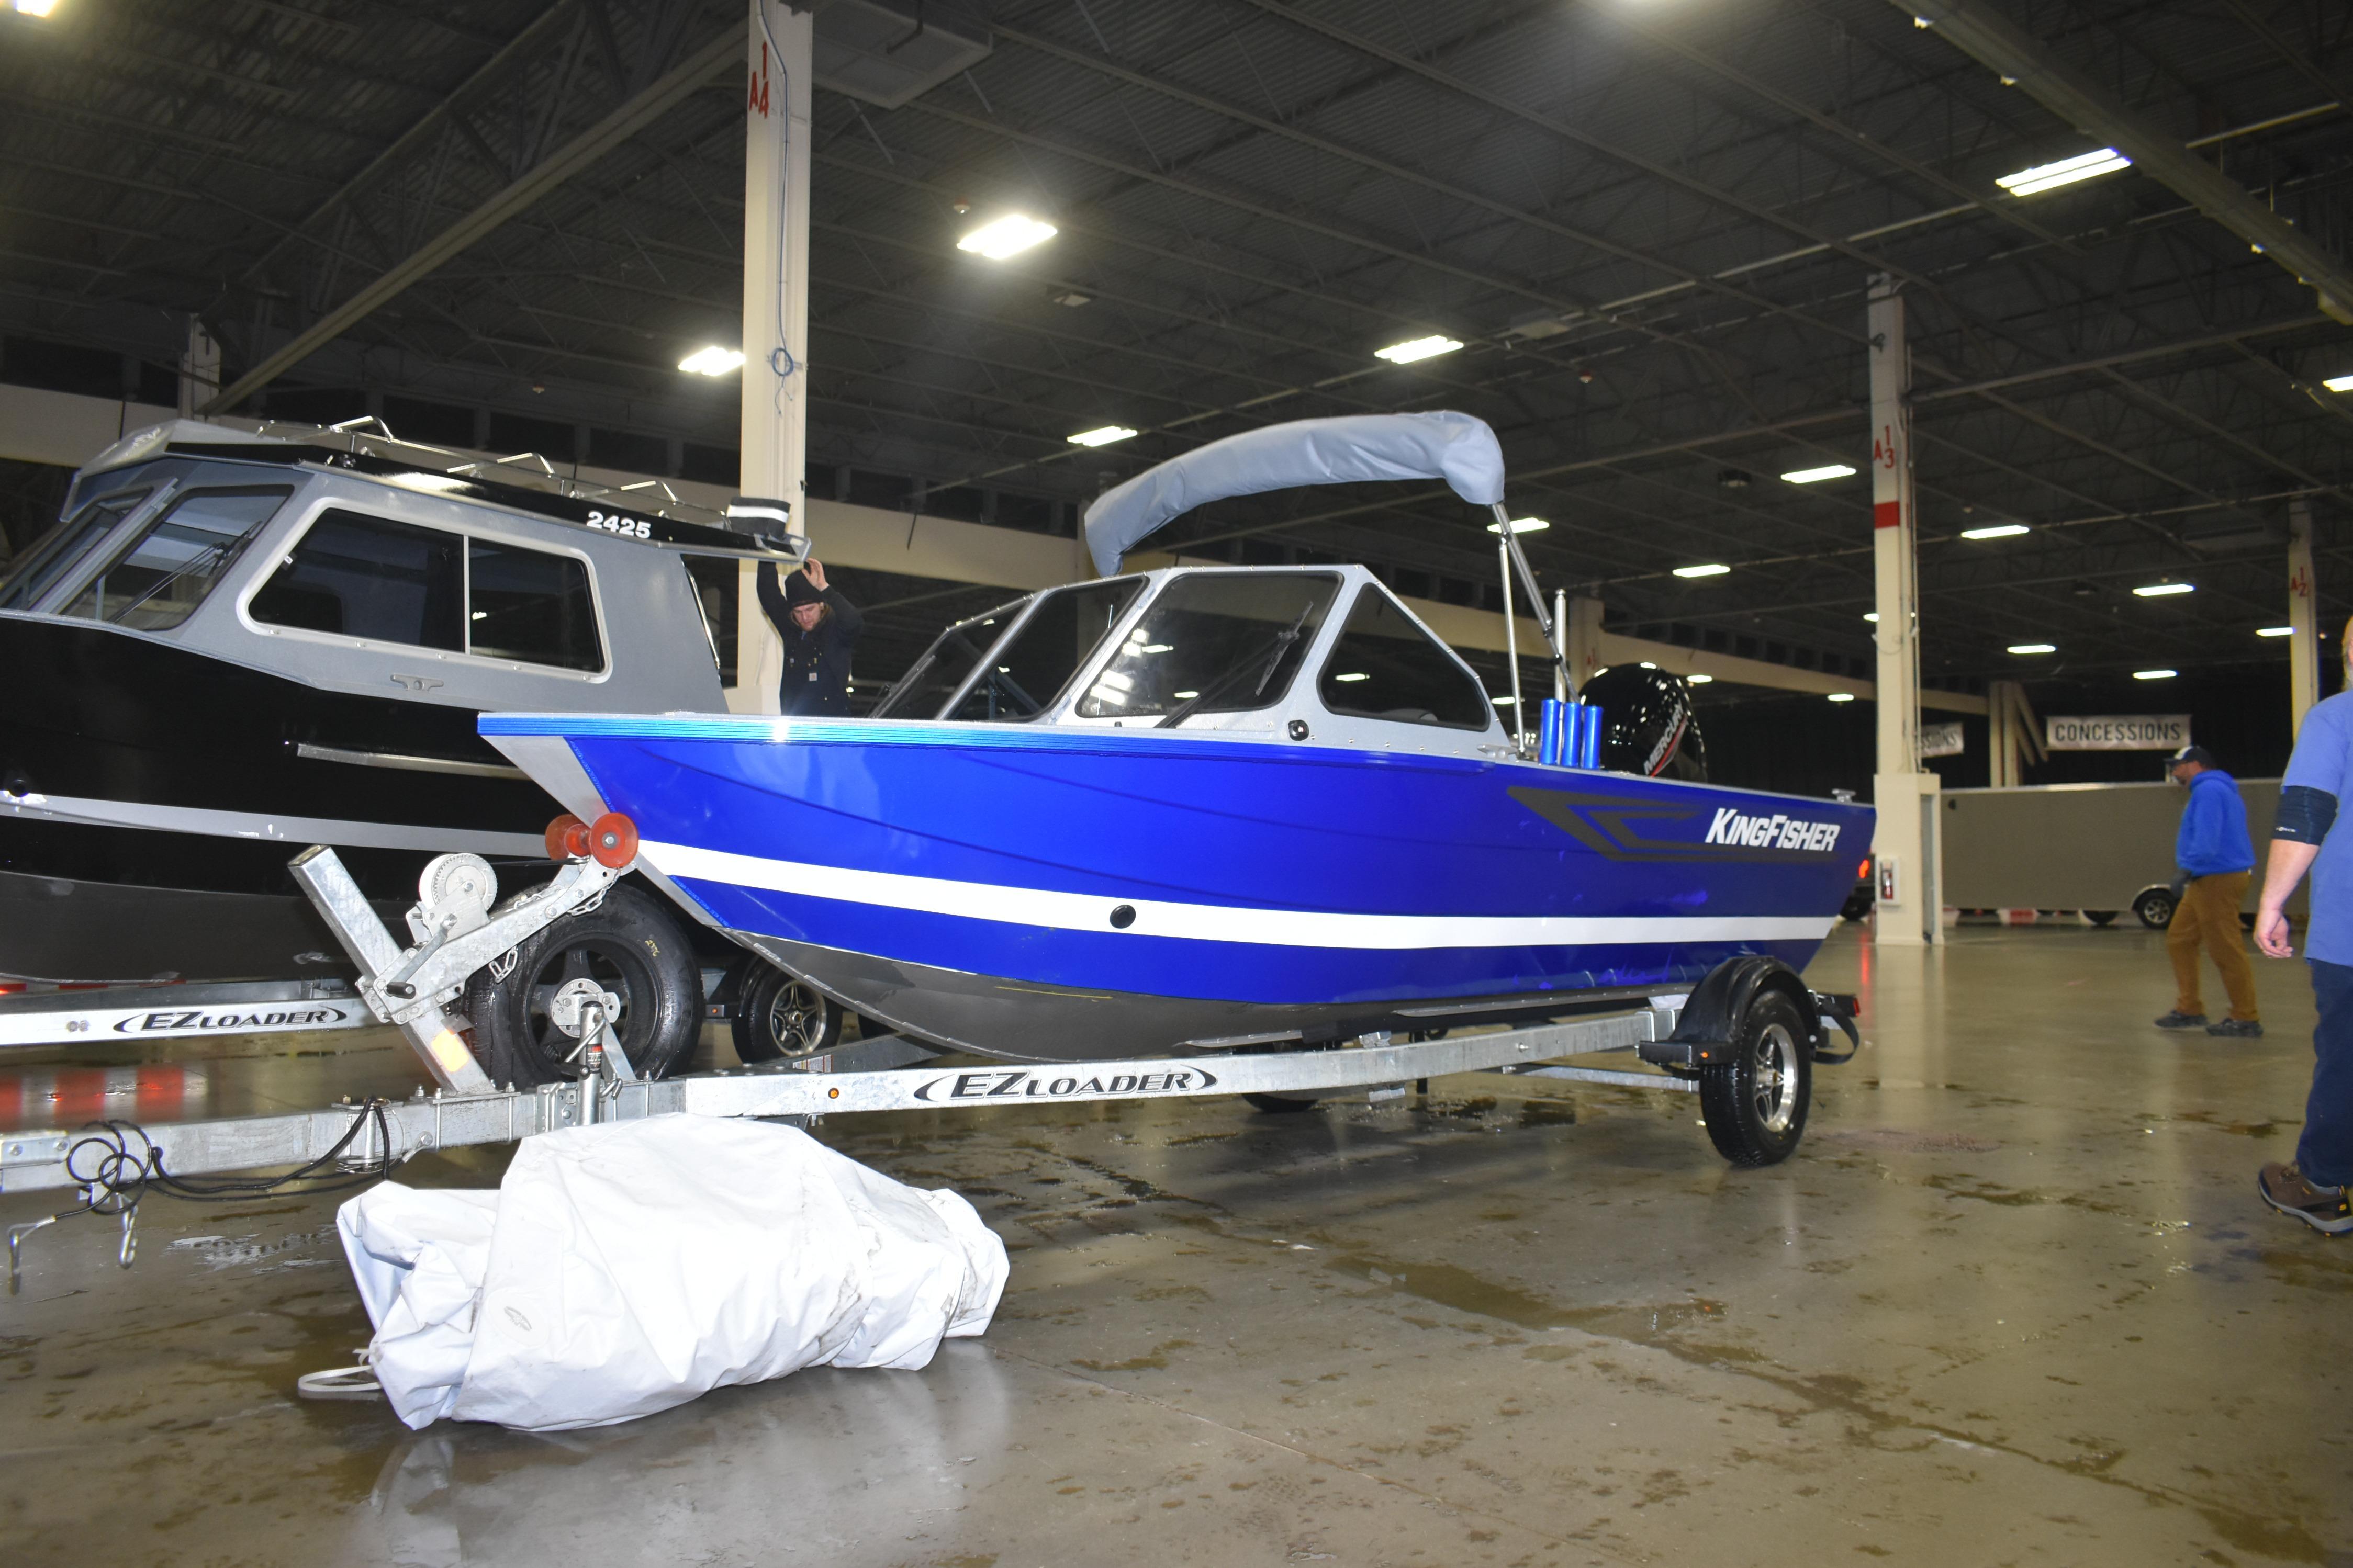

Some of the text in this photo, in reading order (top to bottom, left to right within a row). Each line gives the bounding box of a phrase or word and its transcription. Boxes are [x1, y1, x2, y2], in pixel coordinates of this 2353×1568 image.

[586, 510, 651, 539] 2425
[1644, 697, 1684, 775] MERCURY
[2055, 723, 2181, 742] CONCESSIONS
